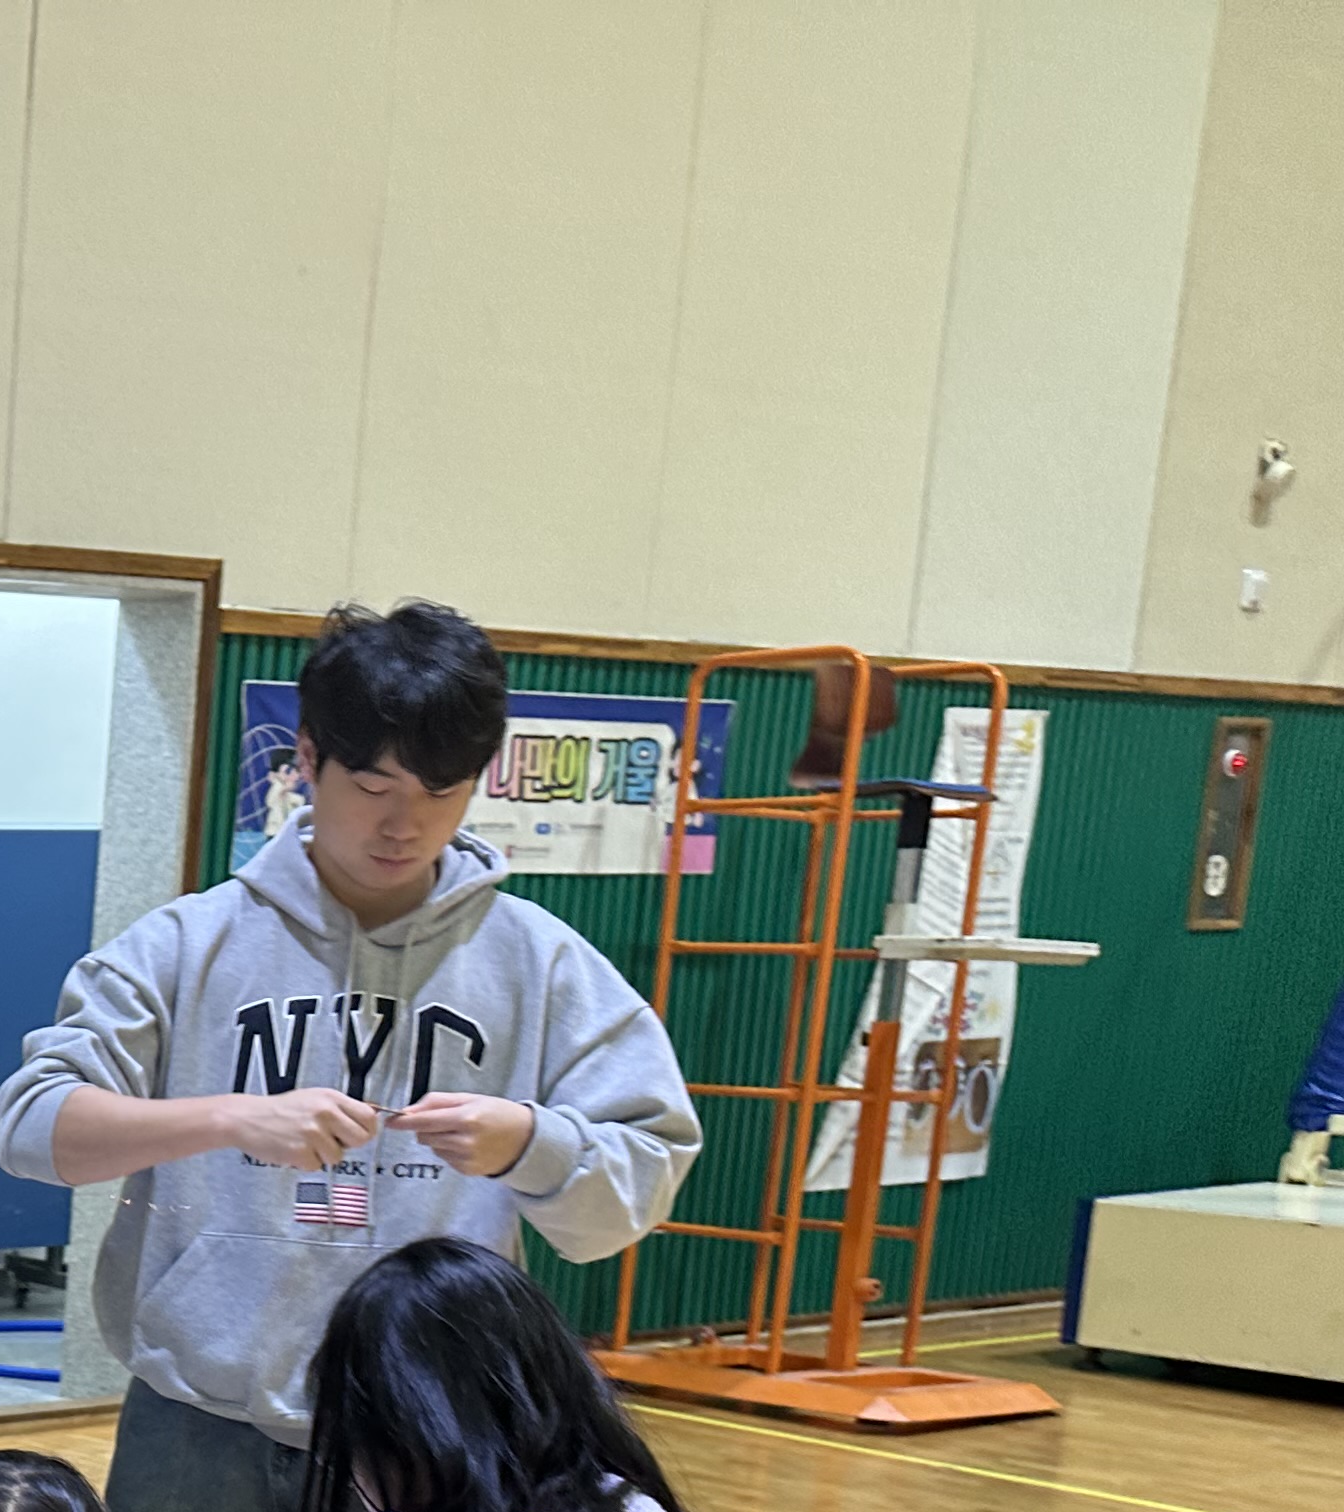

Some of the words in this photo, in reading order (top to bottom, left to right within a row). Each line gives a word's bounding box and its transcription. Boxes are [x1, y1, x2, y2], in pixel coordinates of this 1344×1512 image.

[486, 733, 593, 803] 나만의
[592, 737, 662, 805] 거울
[232, 990, 490, 1106] NYC
[393, 1162, 444, 1180] CITY
